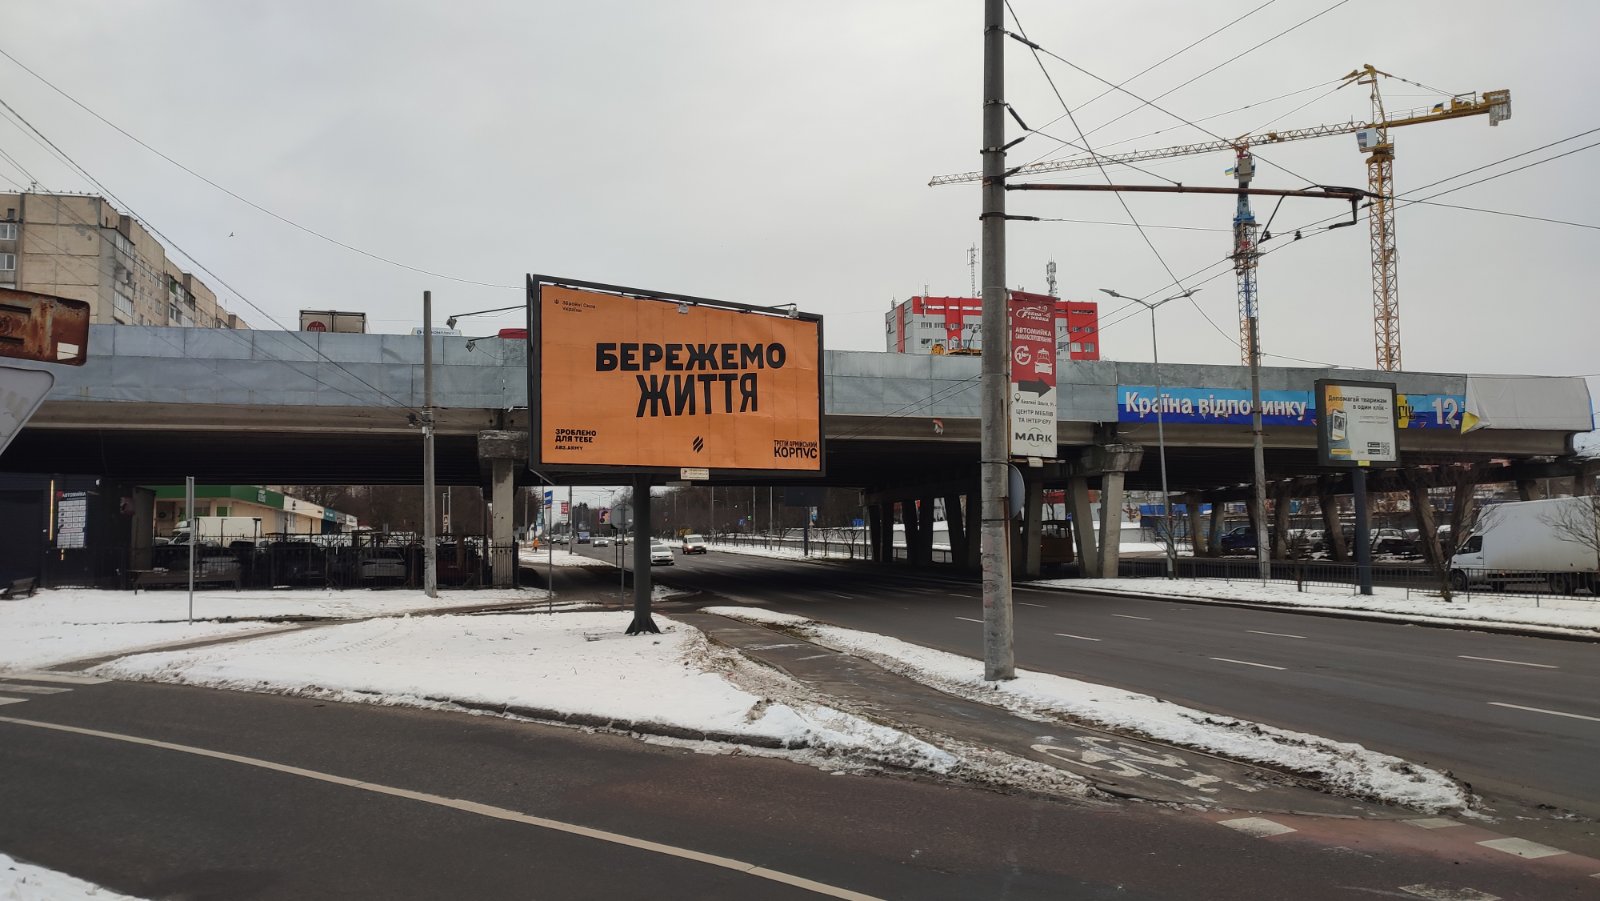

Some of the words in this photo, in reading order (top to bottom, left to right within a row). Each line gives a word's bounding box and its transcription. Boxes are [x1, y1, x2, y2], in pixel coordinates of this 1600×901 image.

[1015, 327, 1052, 337] АВТОМИЙКА
[596, 342, 787, 371] БЕРЕЖЕМО
[636, 373, 758, 418] ЖИТТЯ
[1125, 391, 1193, 418] Країна
[1199, 394, 1306, 420] відпоинку
[555, 428, 597, 437] ЗРОБЛЕНО
[1015, 432, 1052, 443] MARK
[555, 435, 573, 443] ДЛЯ
[774, 447, 818, 459] КОРПУС
